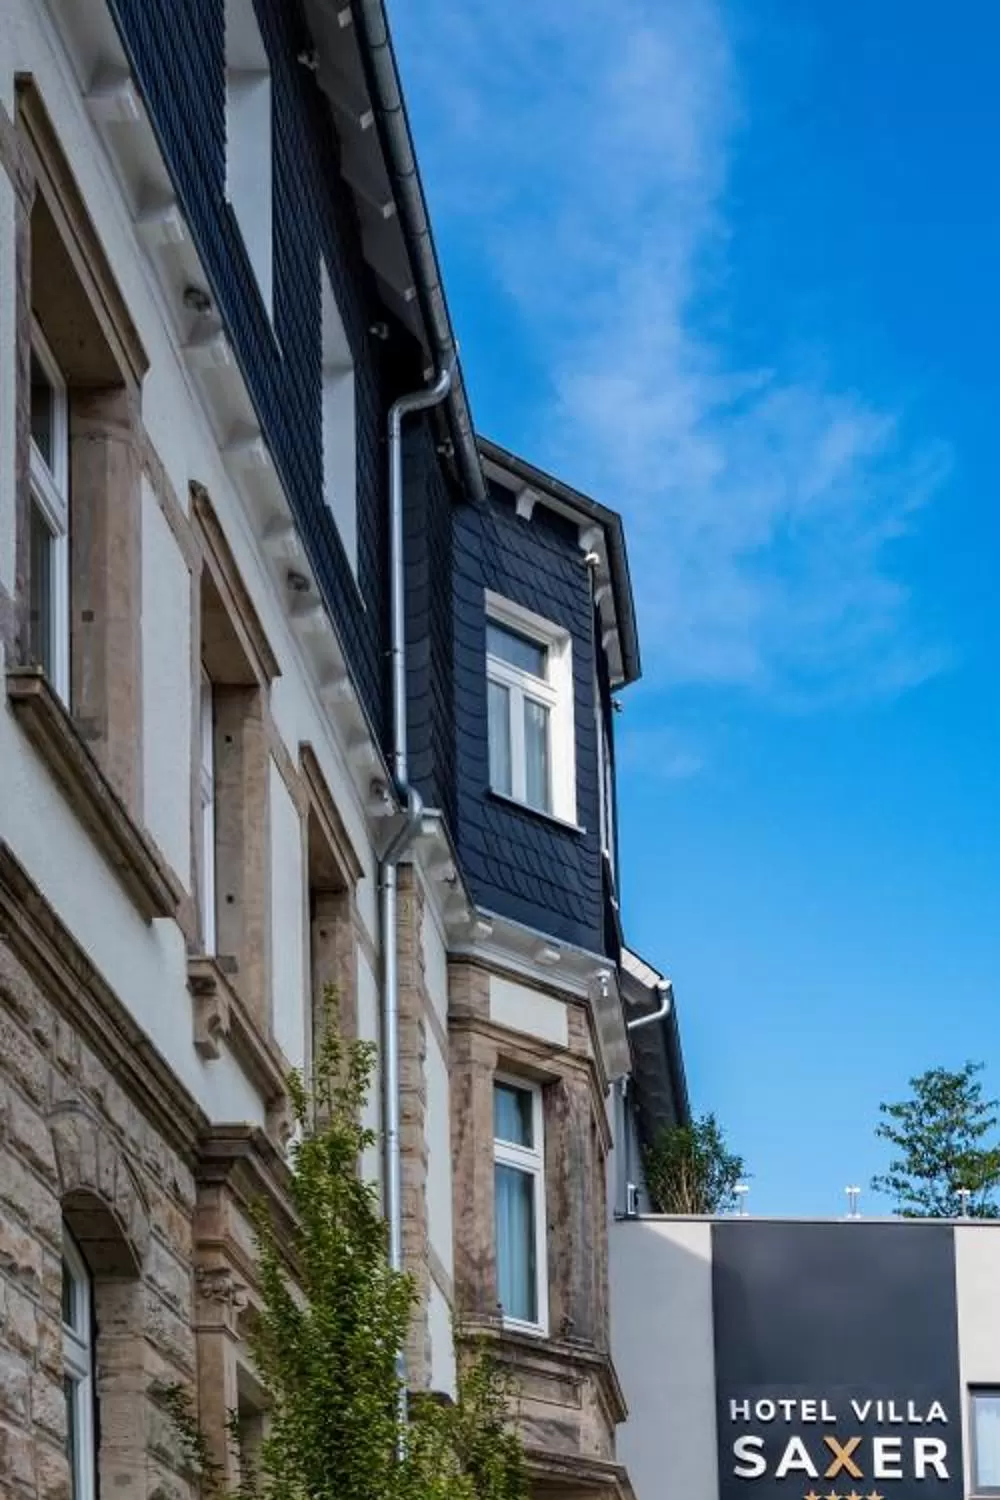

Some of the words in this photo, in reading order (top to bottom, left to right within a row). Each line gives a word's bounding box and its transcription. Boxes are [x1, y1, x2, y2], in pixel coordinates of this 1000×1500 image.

[730, 1399, 837, 1422] HOTEL
[851, 1399, 948, 1423] VILLA
[733, 1435, 950, 1479] SAXER
